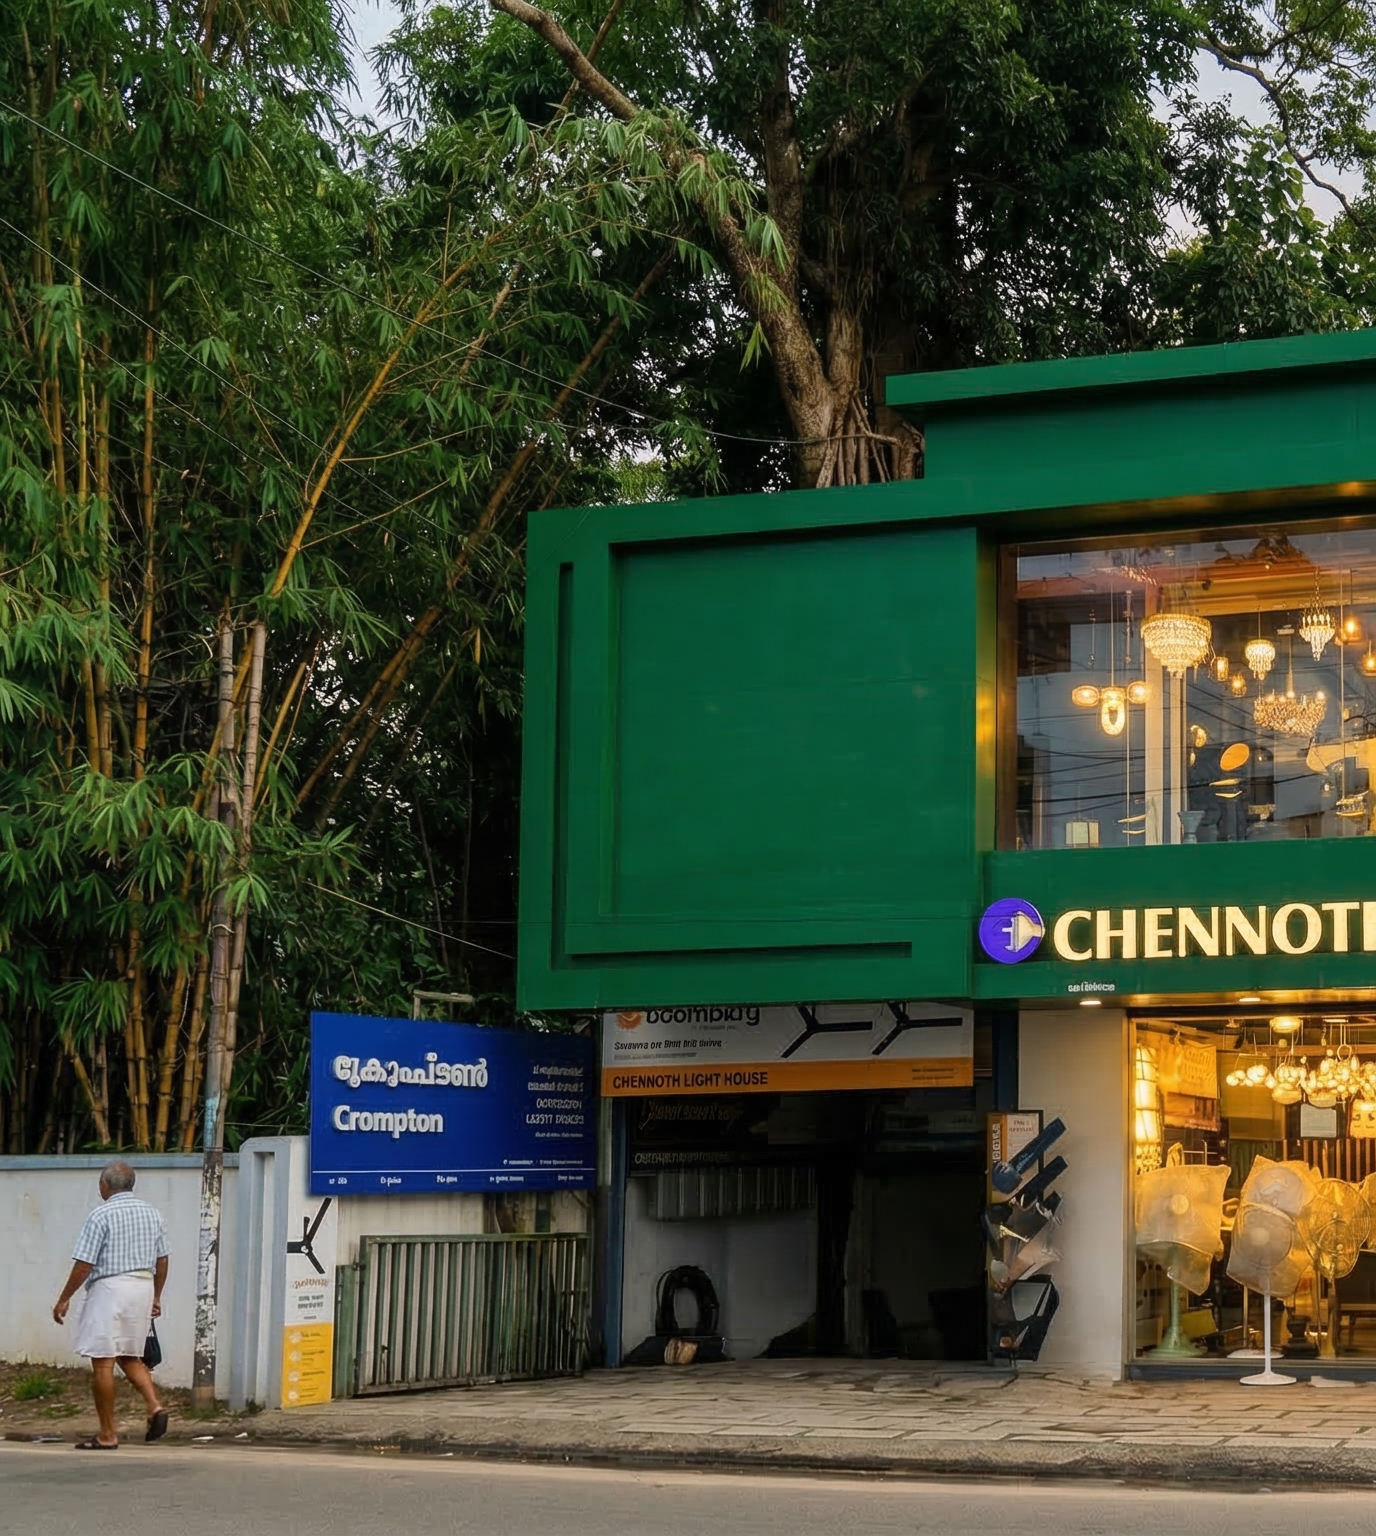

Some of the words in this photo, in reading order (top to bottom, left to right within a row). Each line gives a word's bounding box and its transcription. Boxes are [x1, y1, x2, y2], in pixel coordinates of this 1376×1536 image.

[613, 1073, 681, 1089] CHENNOTH
[684, 1072, 721, 1088] LIGHT
[724, 1071, 769, 1087] HOUSE
[333, 1104, 444, 1139] Crompton
